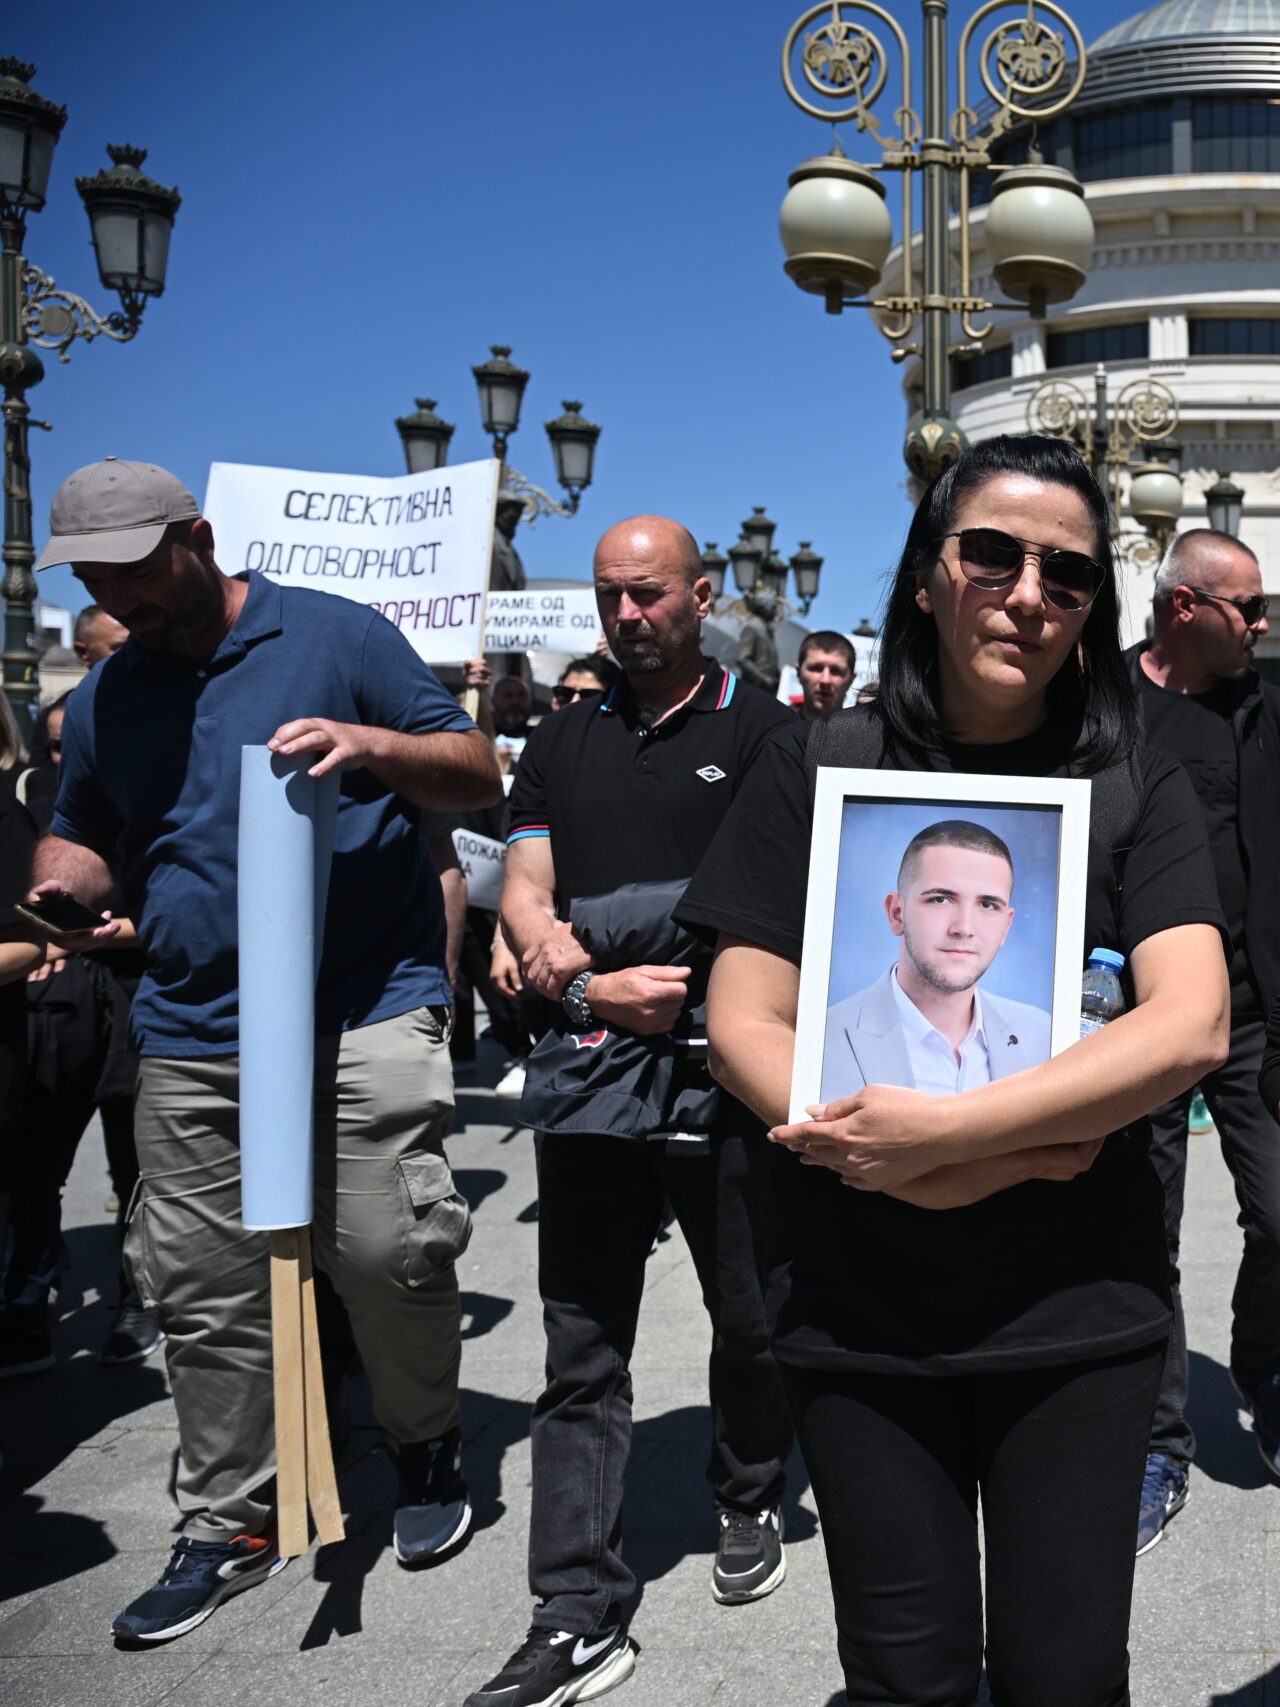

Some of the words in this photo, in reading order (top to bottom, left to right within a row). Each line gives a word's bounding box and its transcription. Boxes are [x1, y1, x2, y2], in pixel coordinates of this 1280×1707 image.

[284, 486, 453, 526] СЕЛЕКТИВНА
[245, 541, 443, 579] ОДГОВОРНОСТ
[489, 597, 535, 610] РАМЕ
[540, 596, 565, 611] ОД
[570, 614, 595, 629] ОД
[485, 634, 547, 649] ПЦИЈА!
